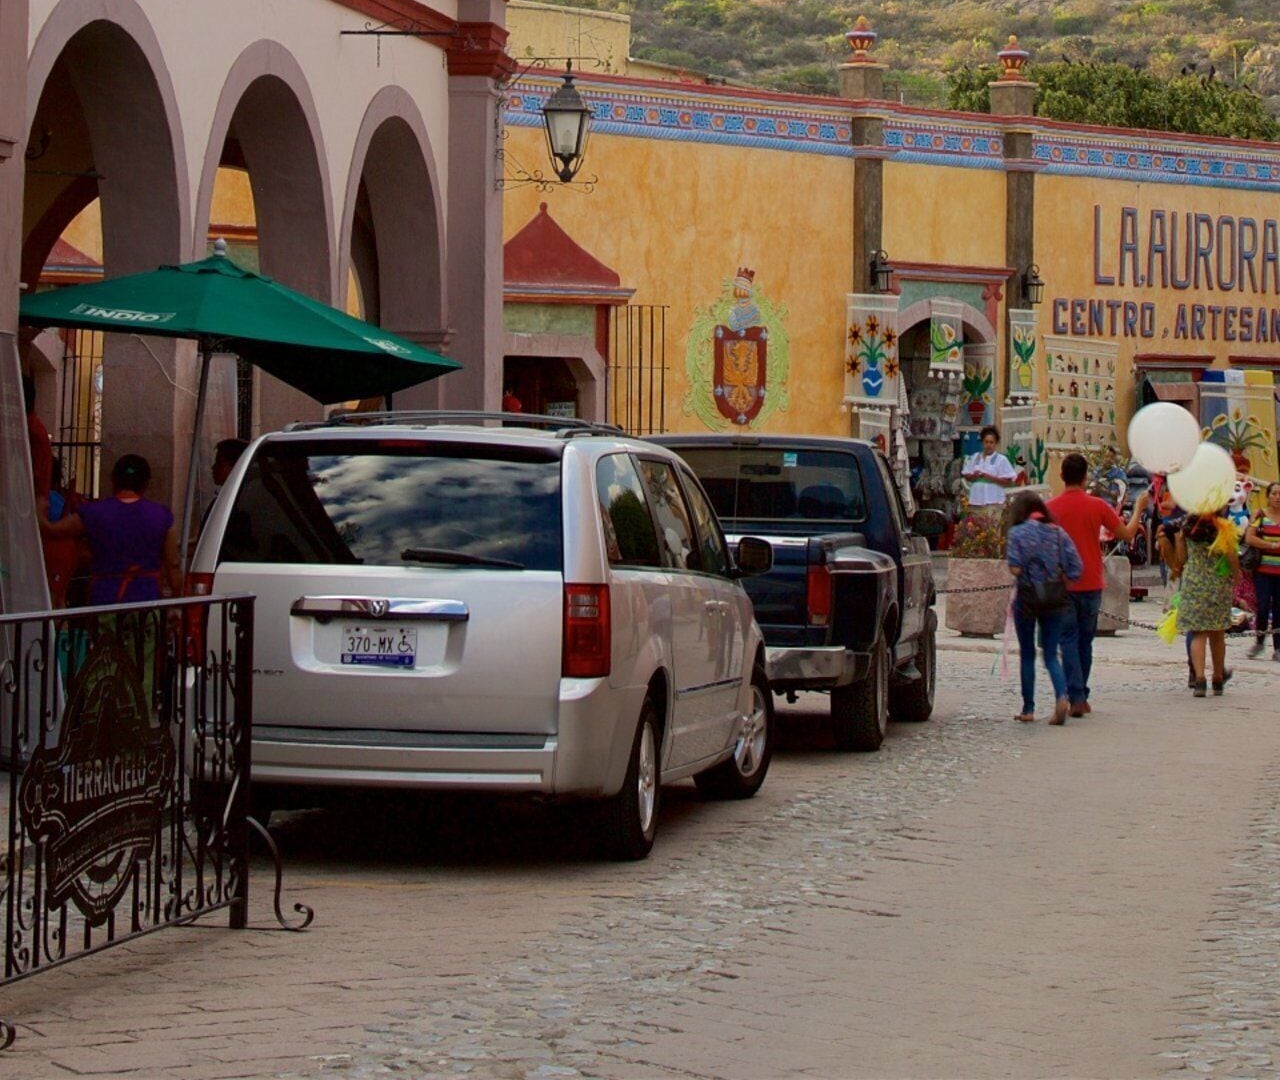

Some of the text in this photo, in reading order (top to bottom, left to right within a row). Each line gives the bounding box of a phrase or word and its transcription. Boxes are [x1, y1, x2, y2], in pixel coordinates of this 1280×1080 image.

[1093, 204, 1280, 295] LA AURORA
[84, 308, 160, 321] INDIO
[1053, 297, 1156, 338] CENTRO
[62, 754, 147, 804] TIERRACIELO
